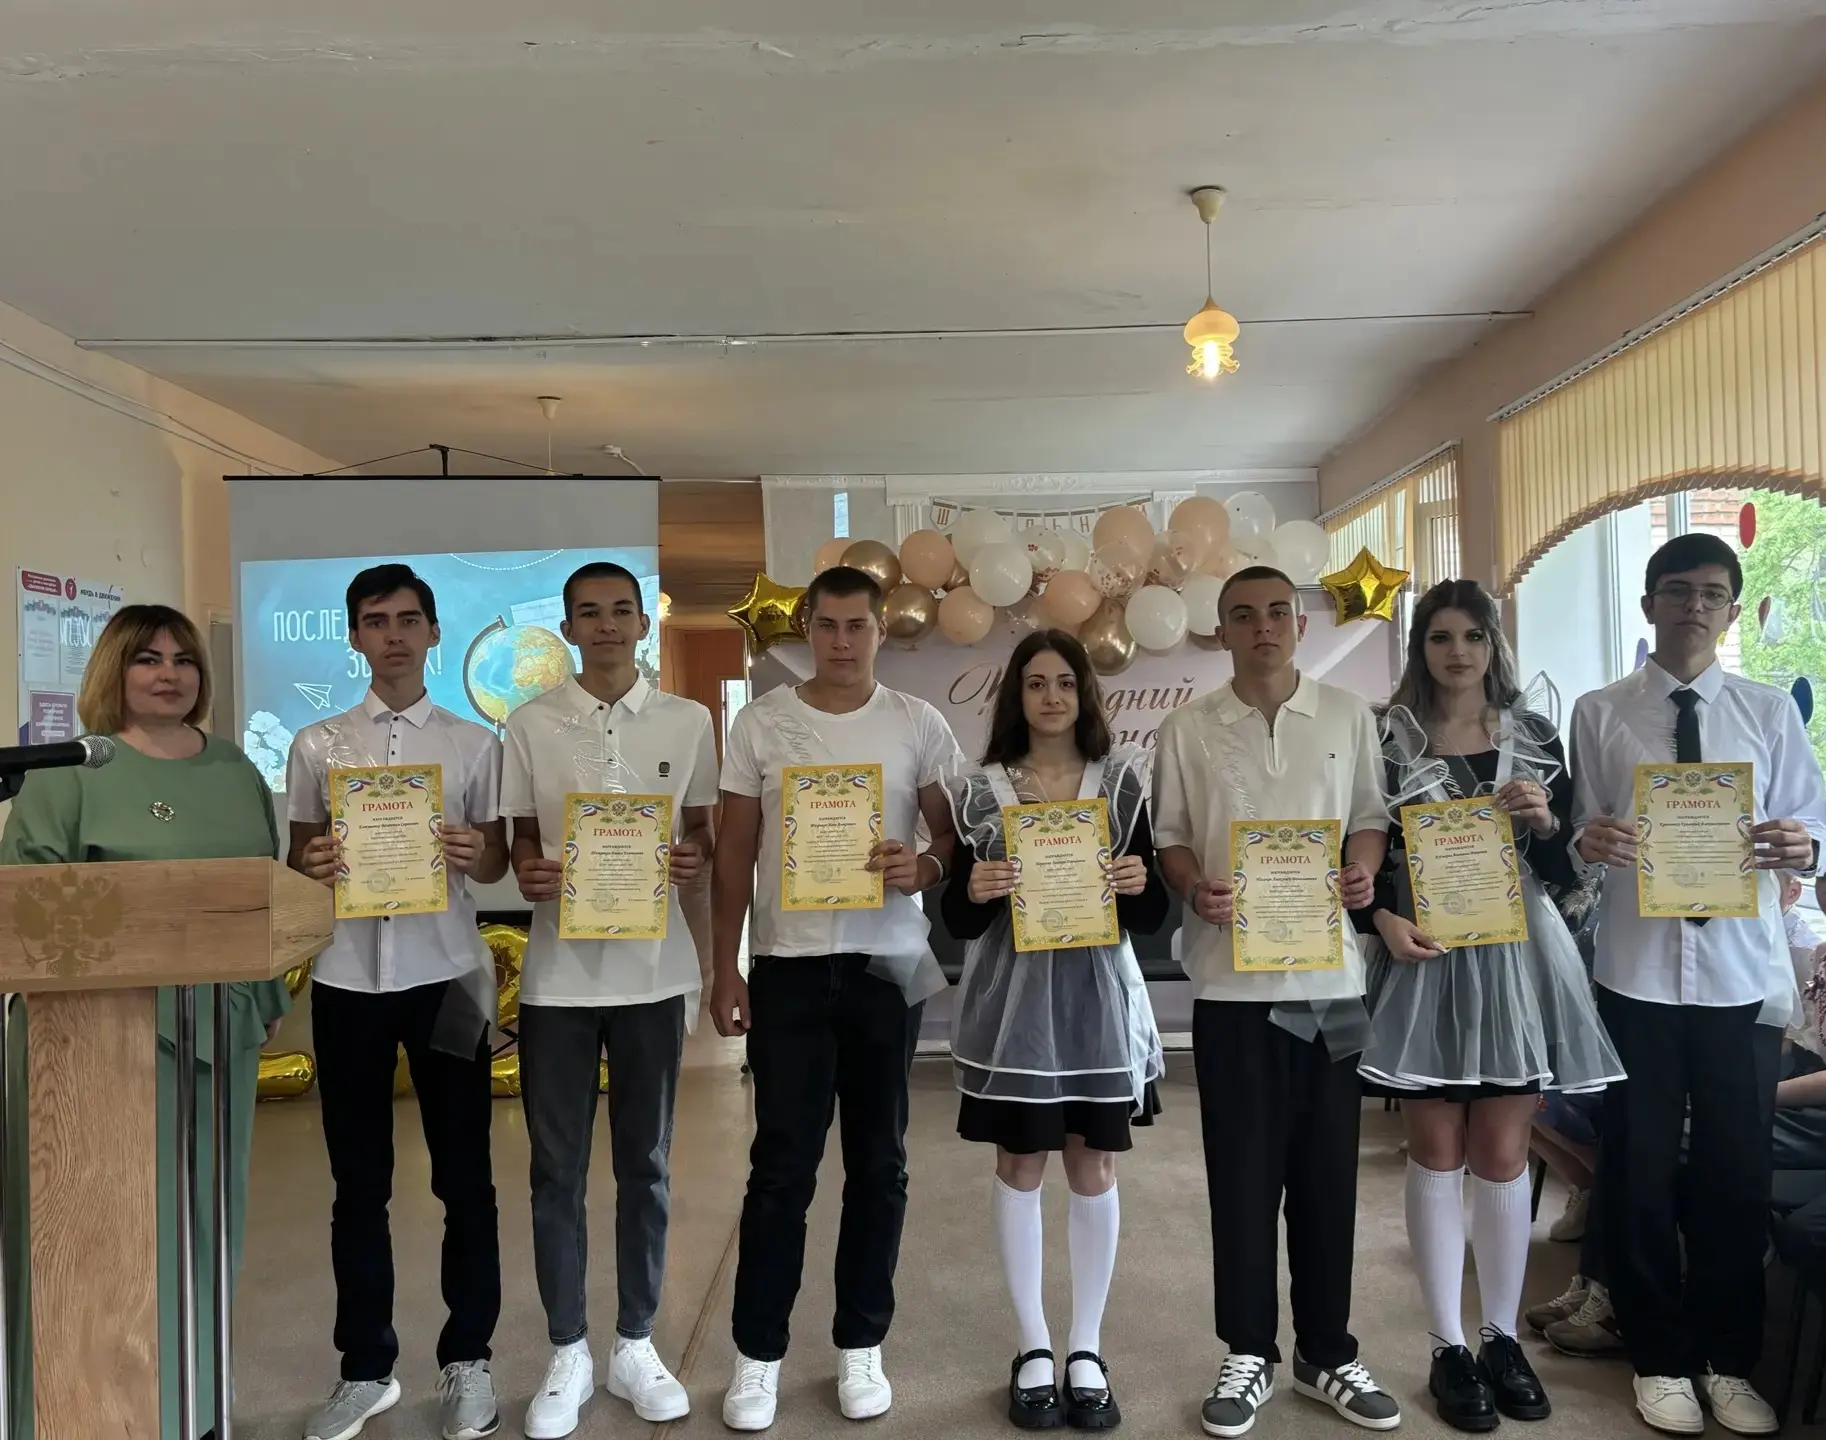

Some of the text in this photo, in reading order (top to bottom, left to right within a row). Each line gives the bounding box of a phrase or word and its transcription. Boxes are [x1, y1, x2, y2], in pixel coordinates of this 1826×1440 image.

[273, 609, 349, 643] ПОСЛЕ
[362, 801, 414, 812] ГРАМОТА
[810, 800, 857, 809] ГРАМОТА
[1666, 800, 1721, 809] ГРАМОТА
[593, 828, 643, 837] ГРАМОТА
[1034, 835, 1082, 847] ГРАМОТА
[1434, 833, 1485, 847] ГРАМОТА
[1260, 855, 1311, 864] ГРАМОТА
